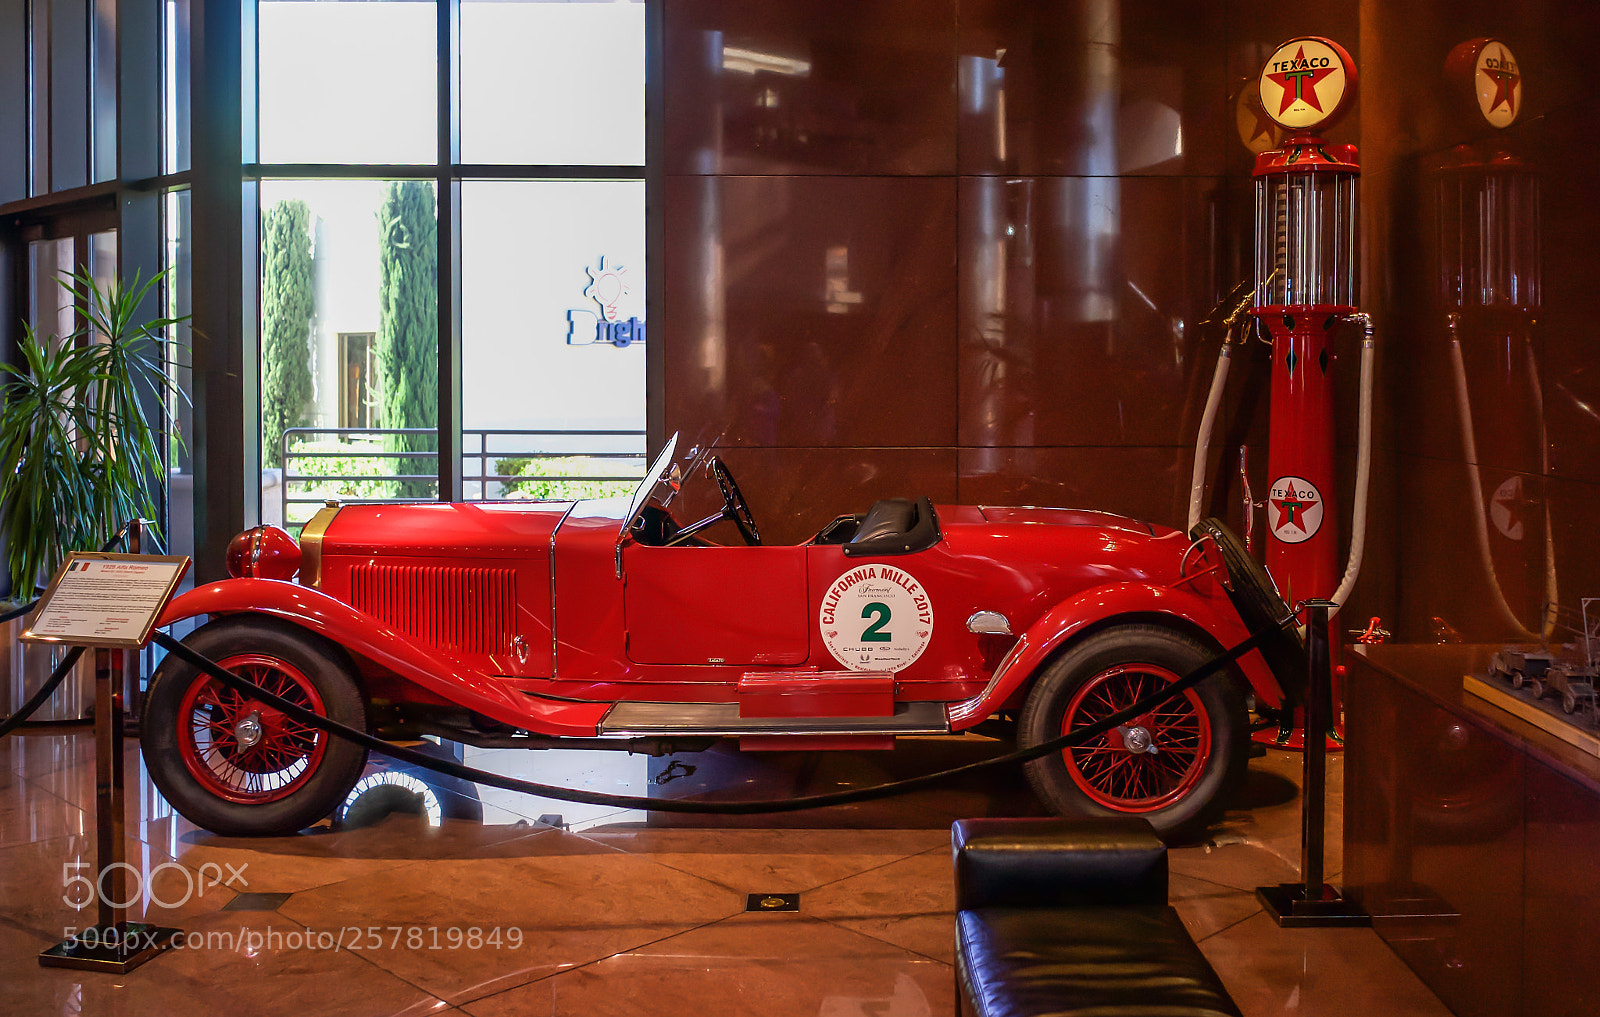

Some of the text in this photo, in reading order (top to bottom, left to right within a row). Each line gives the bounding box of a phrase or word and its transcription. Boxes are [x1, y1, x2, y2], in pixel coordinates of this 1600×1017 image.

[1273, 57, 1330, 73] TEXACO
[1285, 70, 1314, 99] T
[1272, 489, 1314, 499] TEXACO
[1281, 501, 1302, 523] T
[822, 567, 931, 625] CALIFORNIA MILLE 2017
[860, 601, 892, 642] 2
